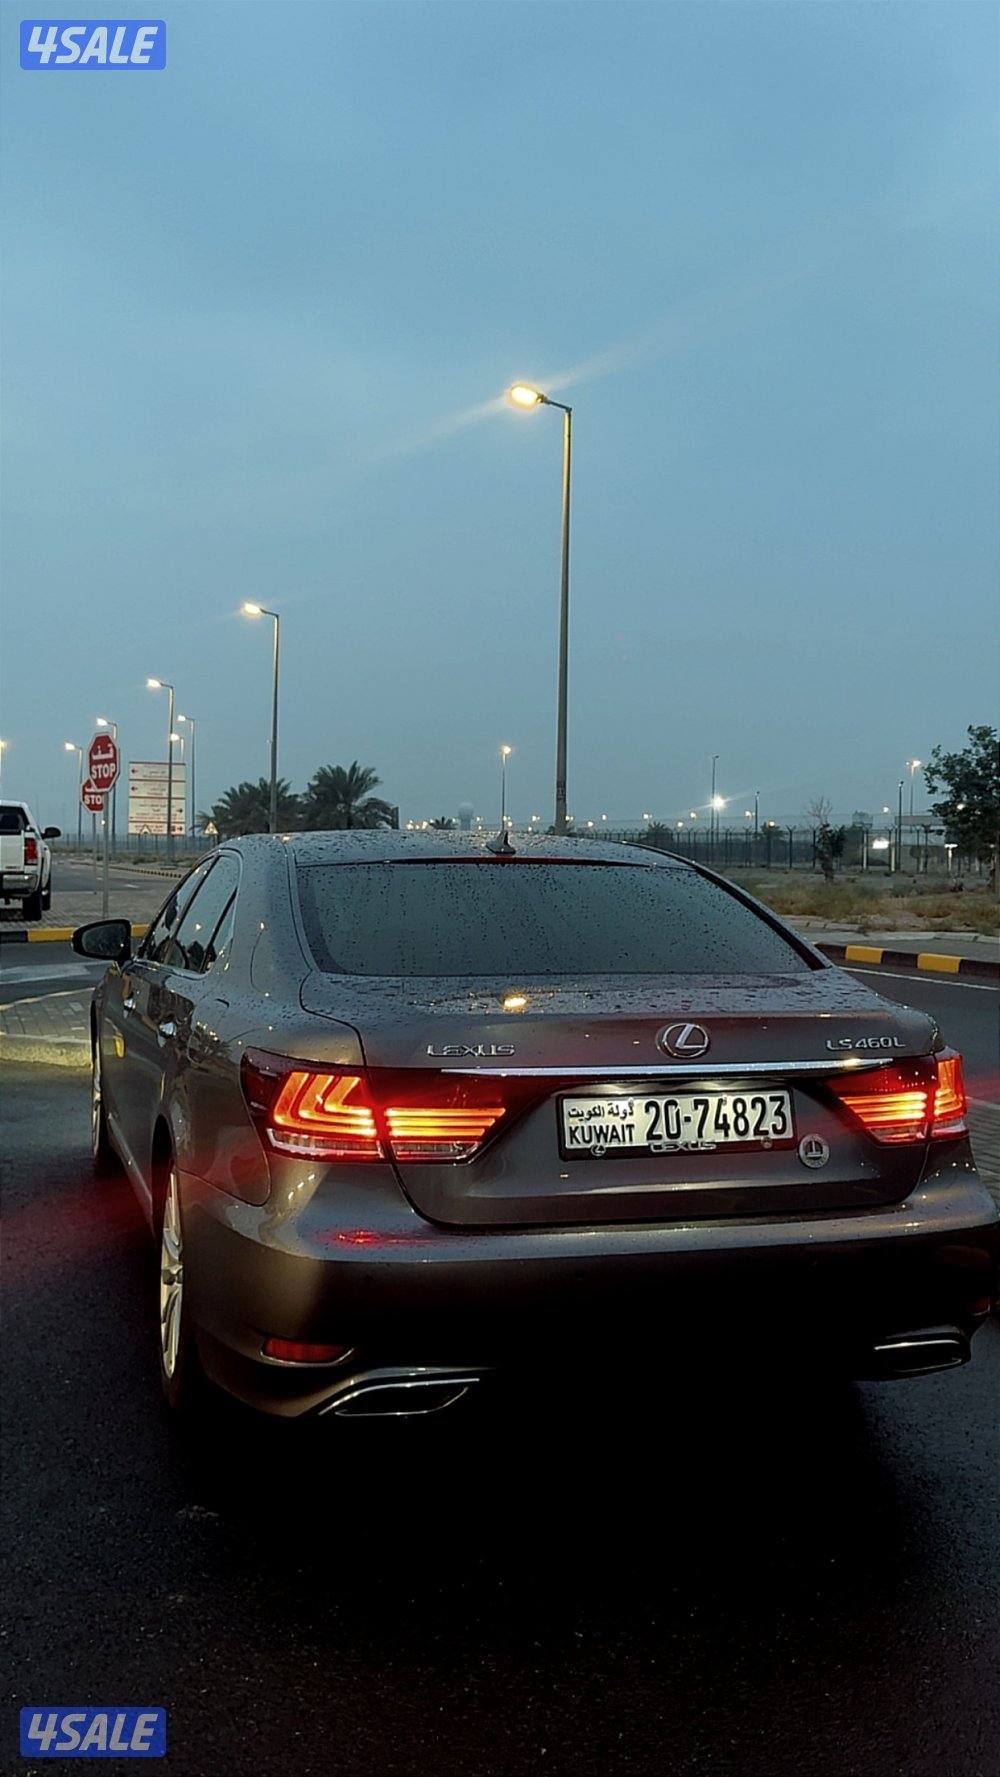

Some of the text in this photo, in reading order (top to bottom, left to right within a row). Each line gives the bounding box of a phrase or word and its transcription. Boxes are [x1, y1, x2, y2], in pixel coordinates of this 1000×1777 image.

[91, 763, 116, 779] STOP
[84, 794, 102, 805] STO
[427, 1044, 515, 1057] LEXUS
[568, 1102, 634, 1122] دولة الكويت
[644, 1096, 787, 1141] 20-74823
[569, 1123, 635, 1145] KUWAIT
